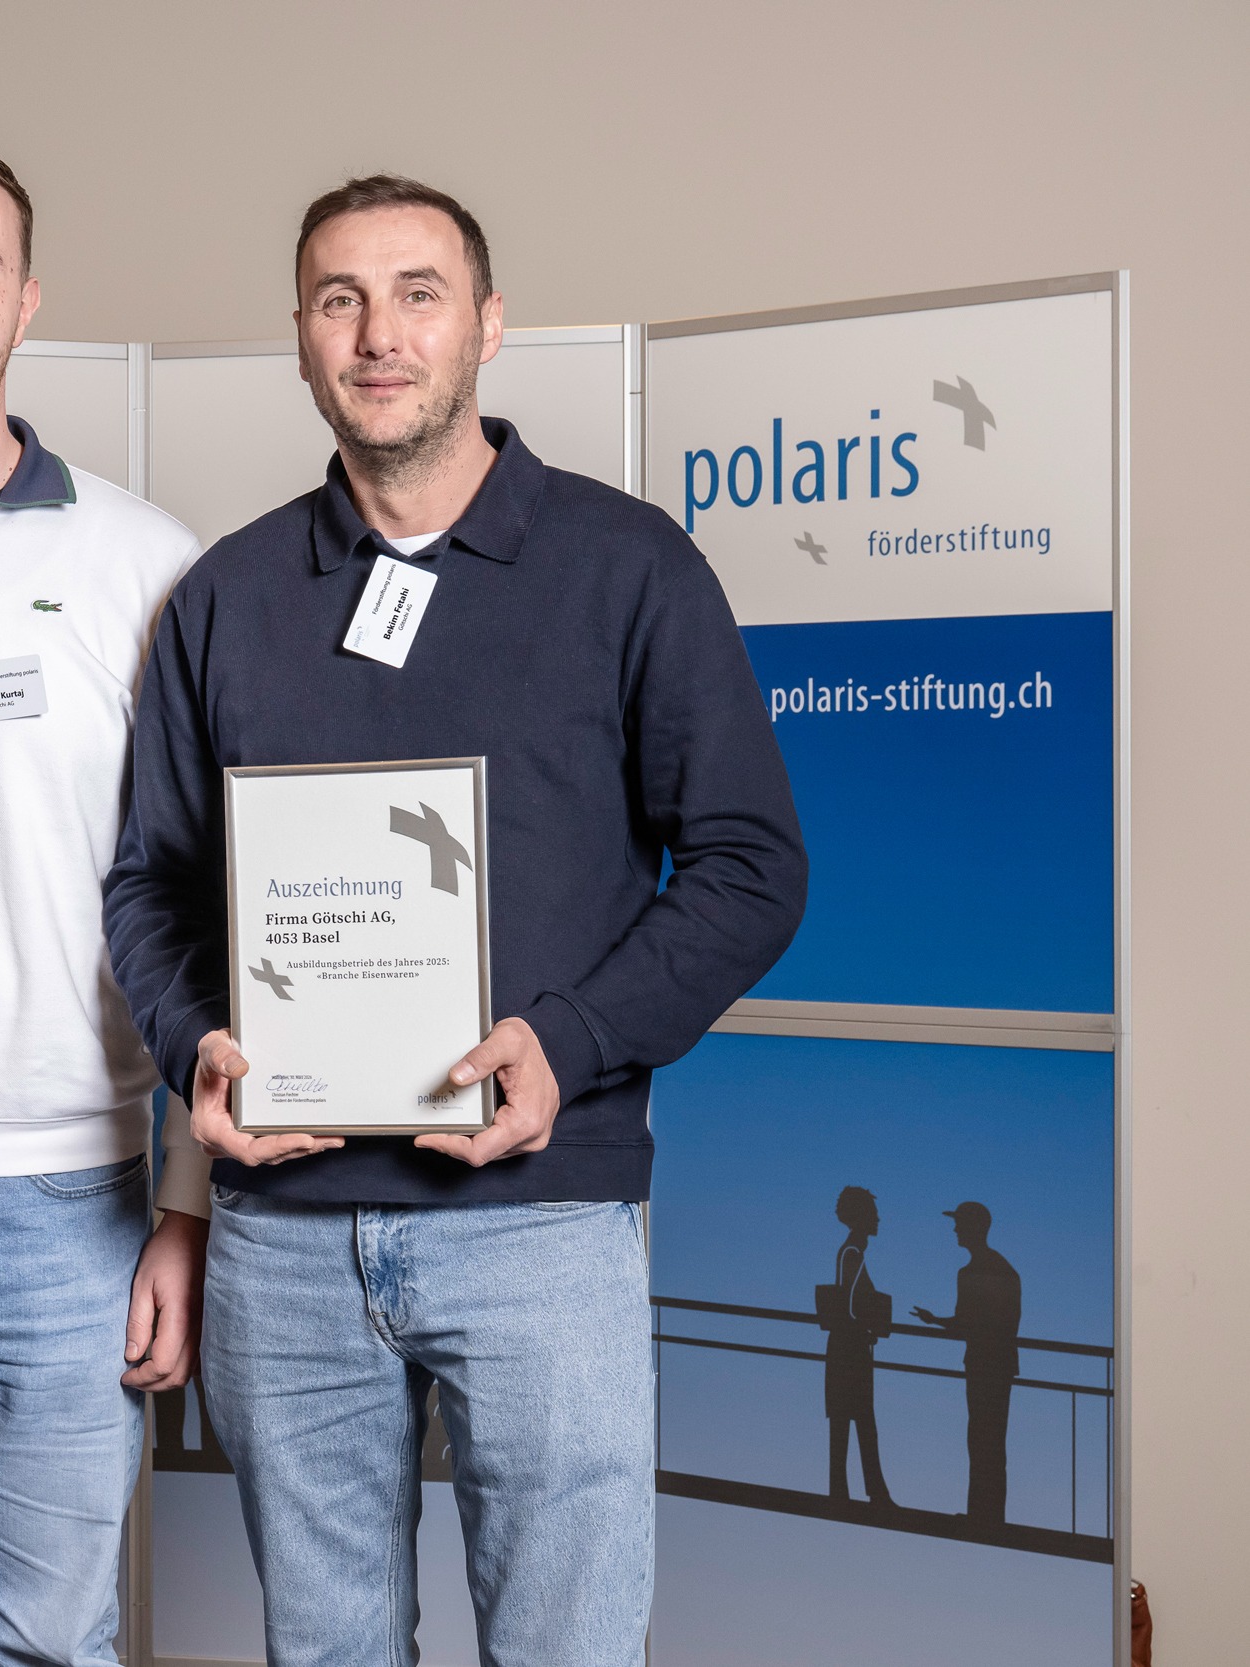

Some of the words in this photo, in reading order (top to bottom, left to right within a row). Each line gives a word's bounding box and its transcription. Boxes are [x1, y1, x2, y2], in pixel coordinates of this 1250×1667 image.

[684, 408, 920, 534] polaris
[867, 523, 1052, 557] förderstiftung
[371, 580, 391, 615] Förderstiftung
[383, 614, 399, 640] Bekim
[394, 587, 410, 613] Fetahi
[407, 603, 413, 613] AG
[23, 668, 39, 677] polaris
[0, 688, 25, 699] Kurtaj
[765, 671, 1053, 723] polaris-stiftung.ch
[266, 876, 403, 900] Auszeichnung
[265, 912, 308, 925] Firma
[312, 910, 367, 925] Götschi
[370, 910, 396, 925] AG,
[265, 932, 298, 945] 4053
[302, 931, 340, 944] Basel
[286, 959, 375, 969] Ausbildungsbetrieb
[377, 959, 393, 967] des
[394, 958, 424, 968] Jahres
[426, 957, 450, 966] 2025:
[316, 971, 360, 980] «Branche
[361, 970, 420, 979] Eisenwaren»
[417, 1092, 449, 1106] polaris
